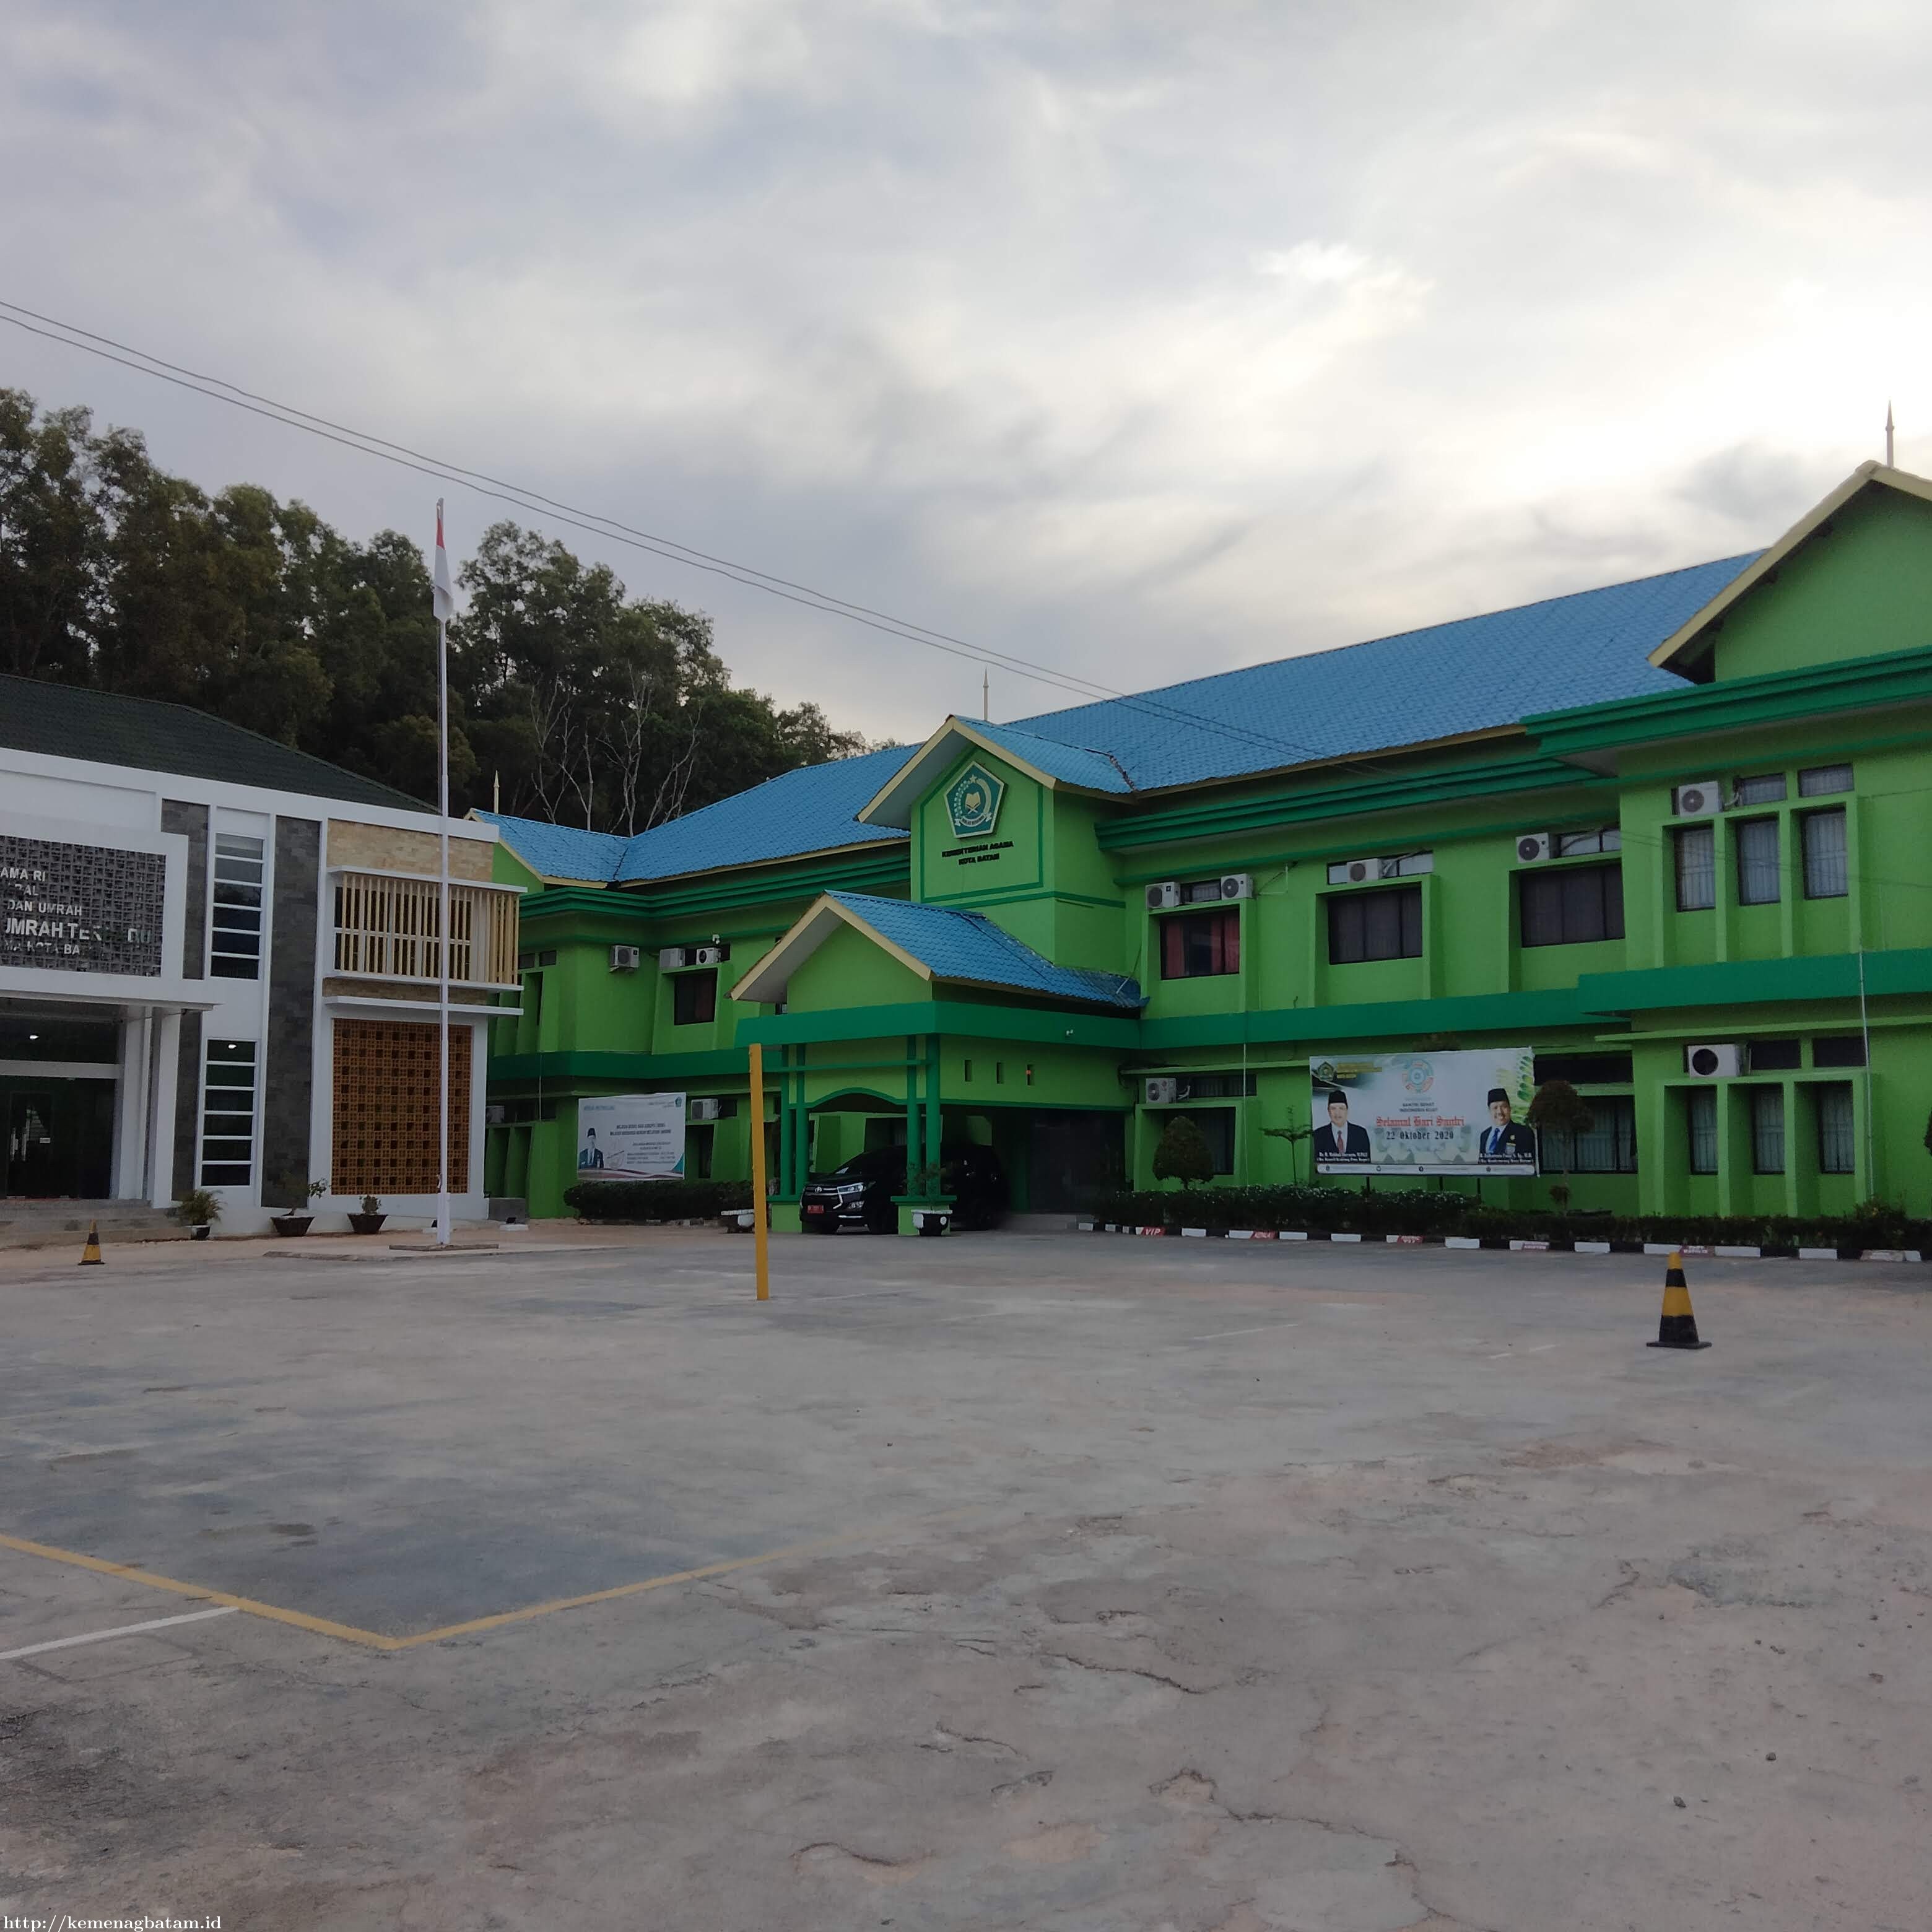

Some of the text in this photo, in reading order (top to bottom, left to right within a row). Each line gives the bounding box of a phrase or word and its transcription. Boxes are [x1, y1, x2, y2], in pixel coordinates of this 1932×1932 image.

[33, 869, 46, 882] RI
[7, 899, 82, 916] DAN UMRAH
[1386, 1131, 1454, 1140] 22 Oktober 2020
